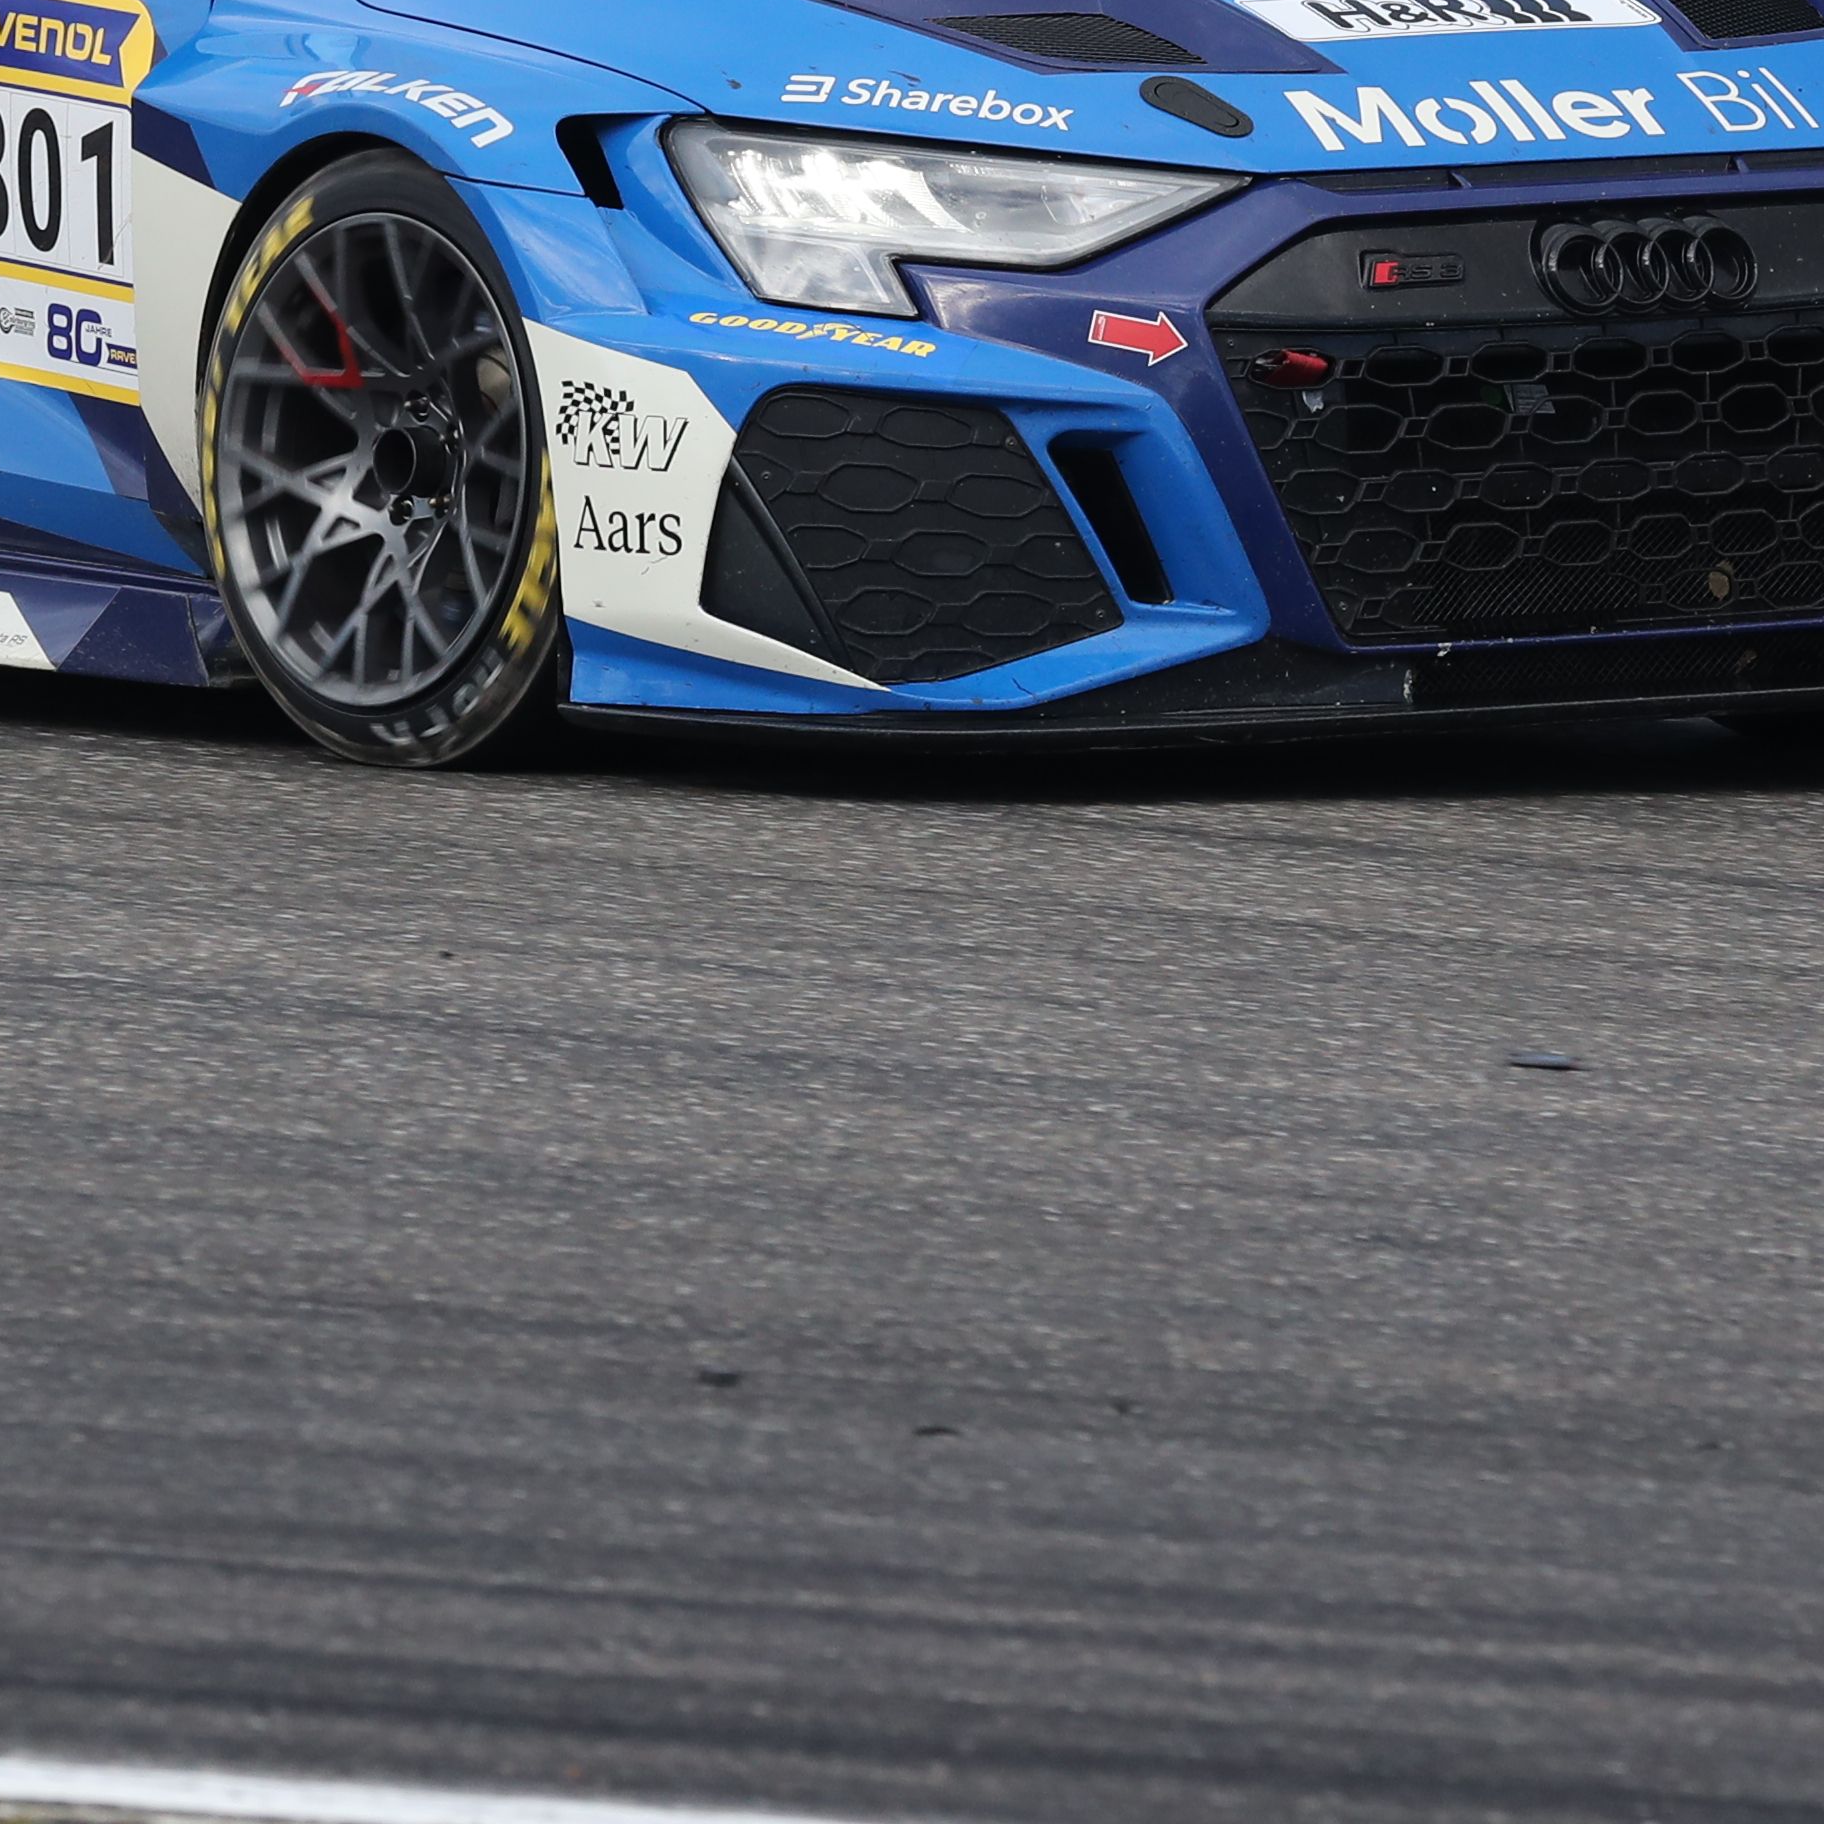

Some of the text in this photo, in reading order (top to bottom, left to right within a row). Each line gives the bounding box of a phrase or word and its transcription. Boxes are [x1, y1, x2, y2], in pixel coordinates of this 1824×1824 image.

[280, 69, 515, 149] FALKEN
[841, 77, 1074, 131] Sharebox
[1677, 66, 1820, 133] Bil
[689, 311, 937, 358] GOODYEAR
[573, 495, 683, 556] Aars
